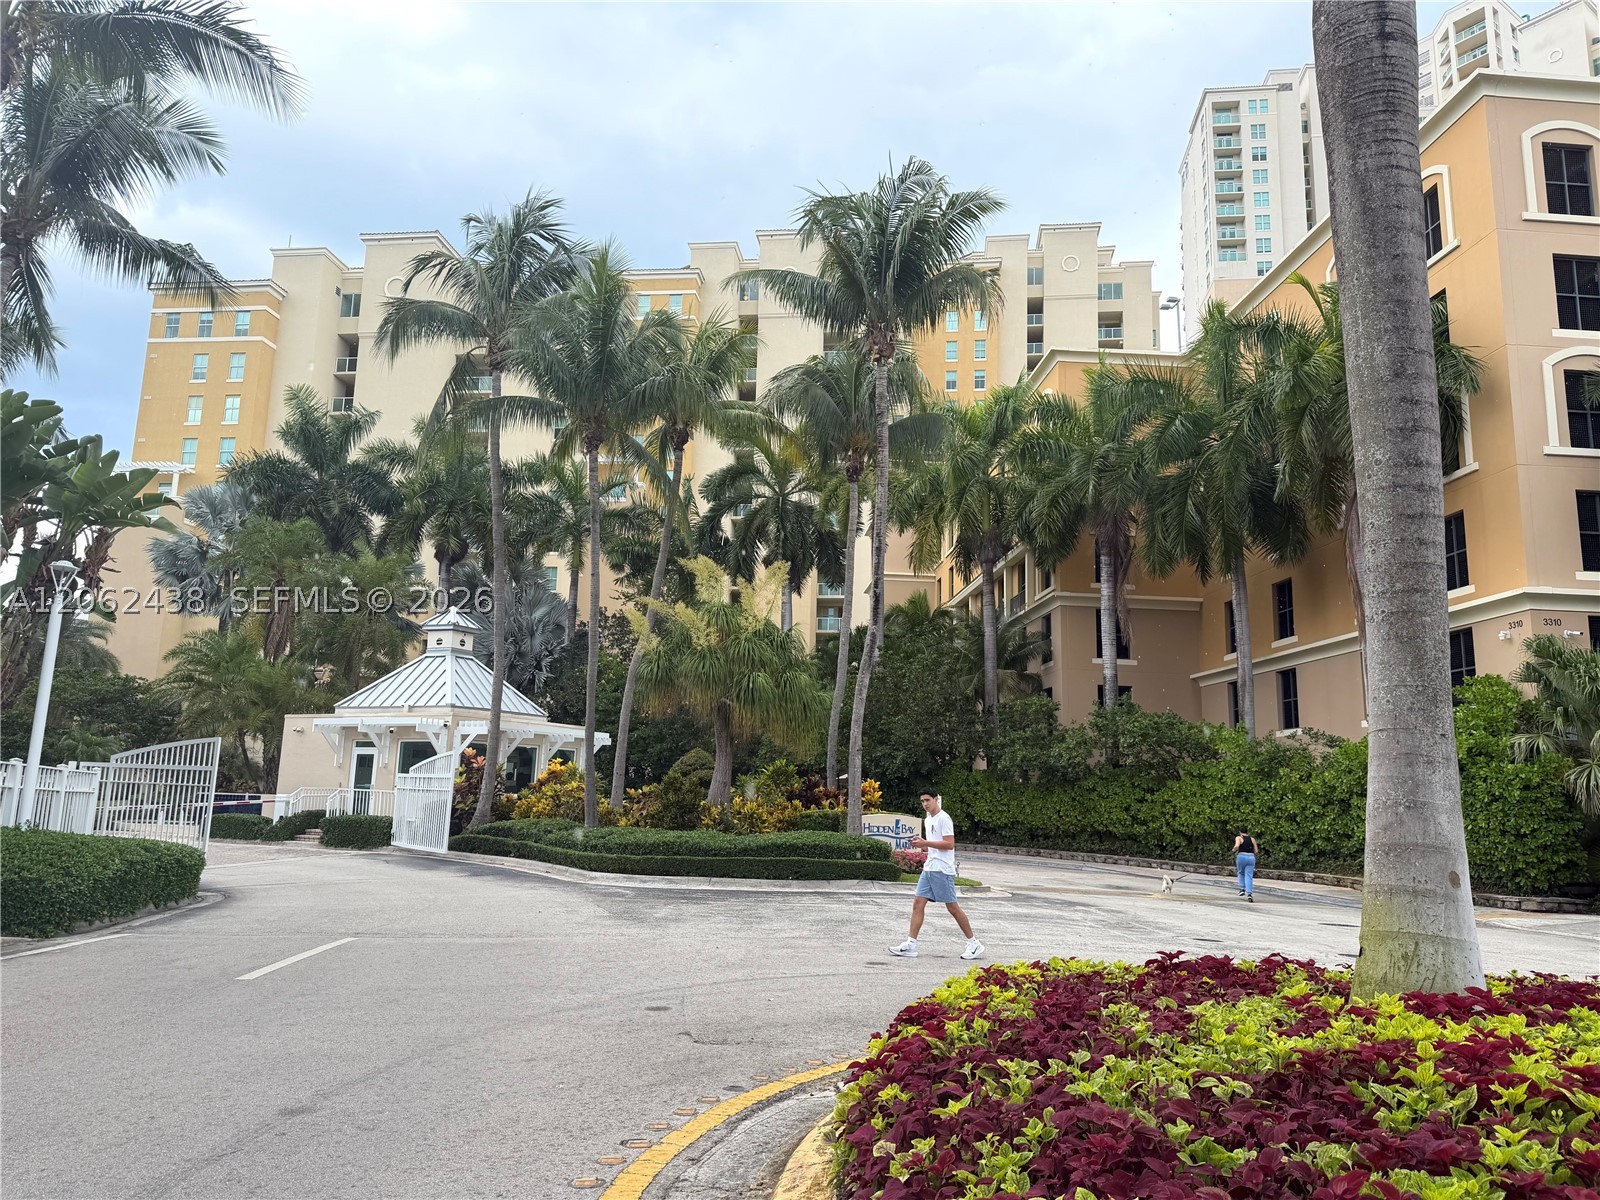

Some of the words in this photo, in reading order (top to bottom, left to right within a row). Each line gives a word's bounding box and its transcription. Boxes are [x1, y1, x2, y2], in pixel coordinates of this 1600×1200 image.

[1508, 620, 1523, 630] 3310
[1542, 618, 1562, 627] 3310
[863, 823, 895, 833] HIDDEN
[901, 824, 916, 834] BAY
